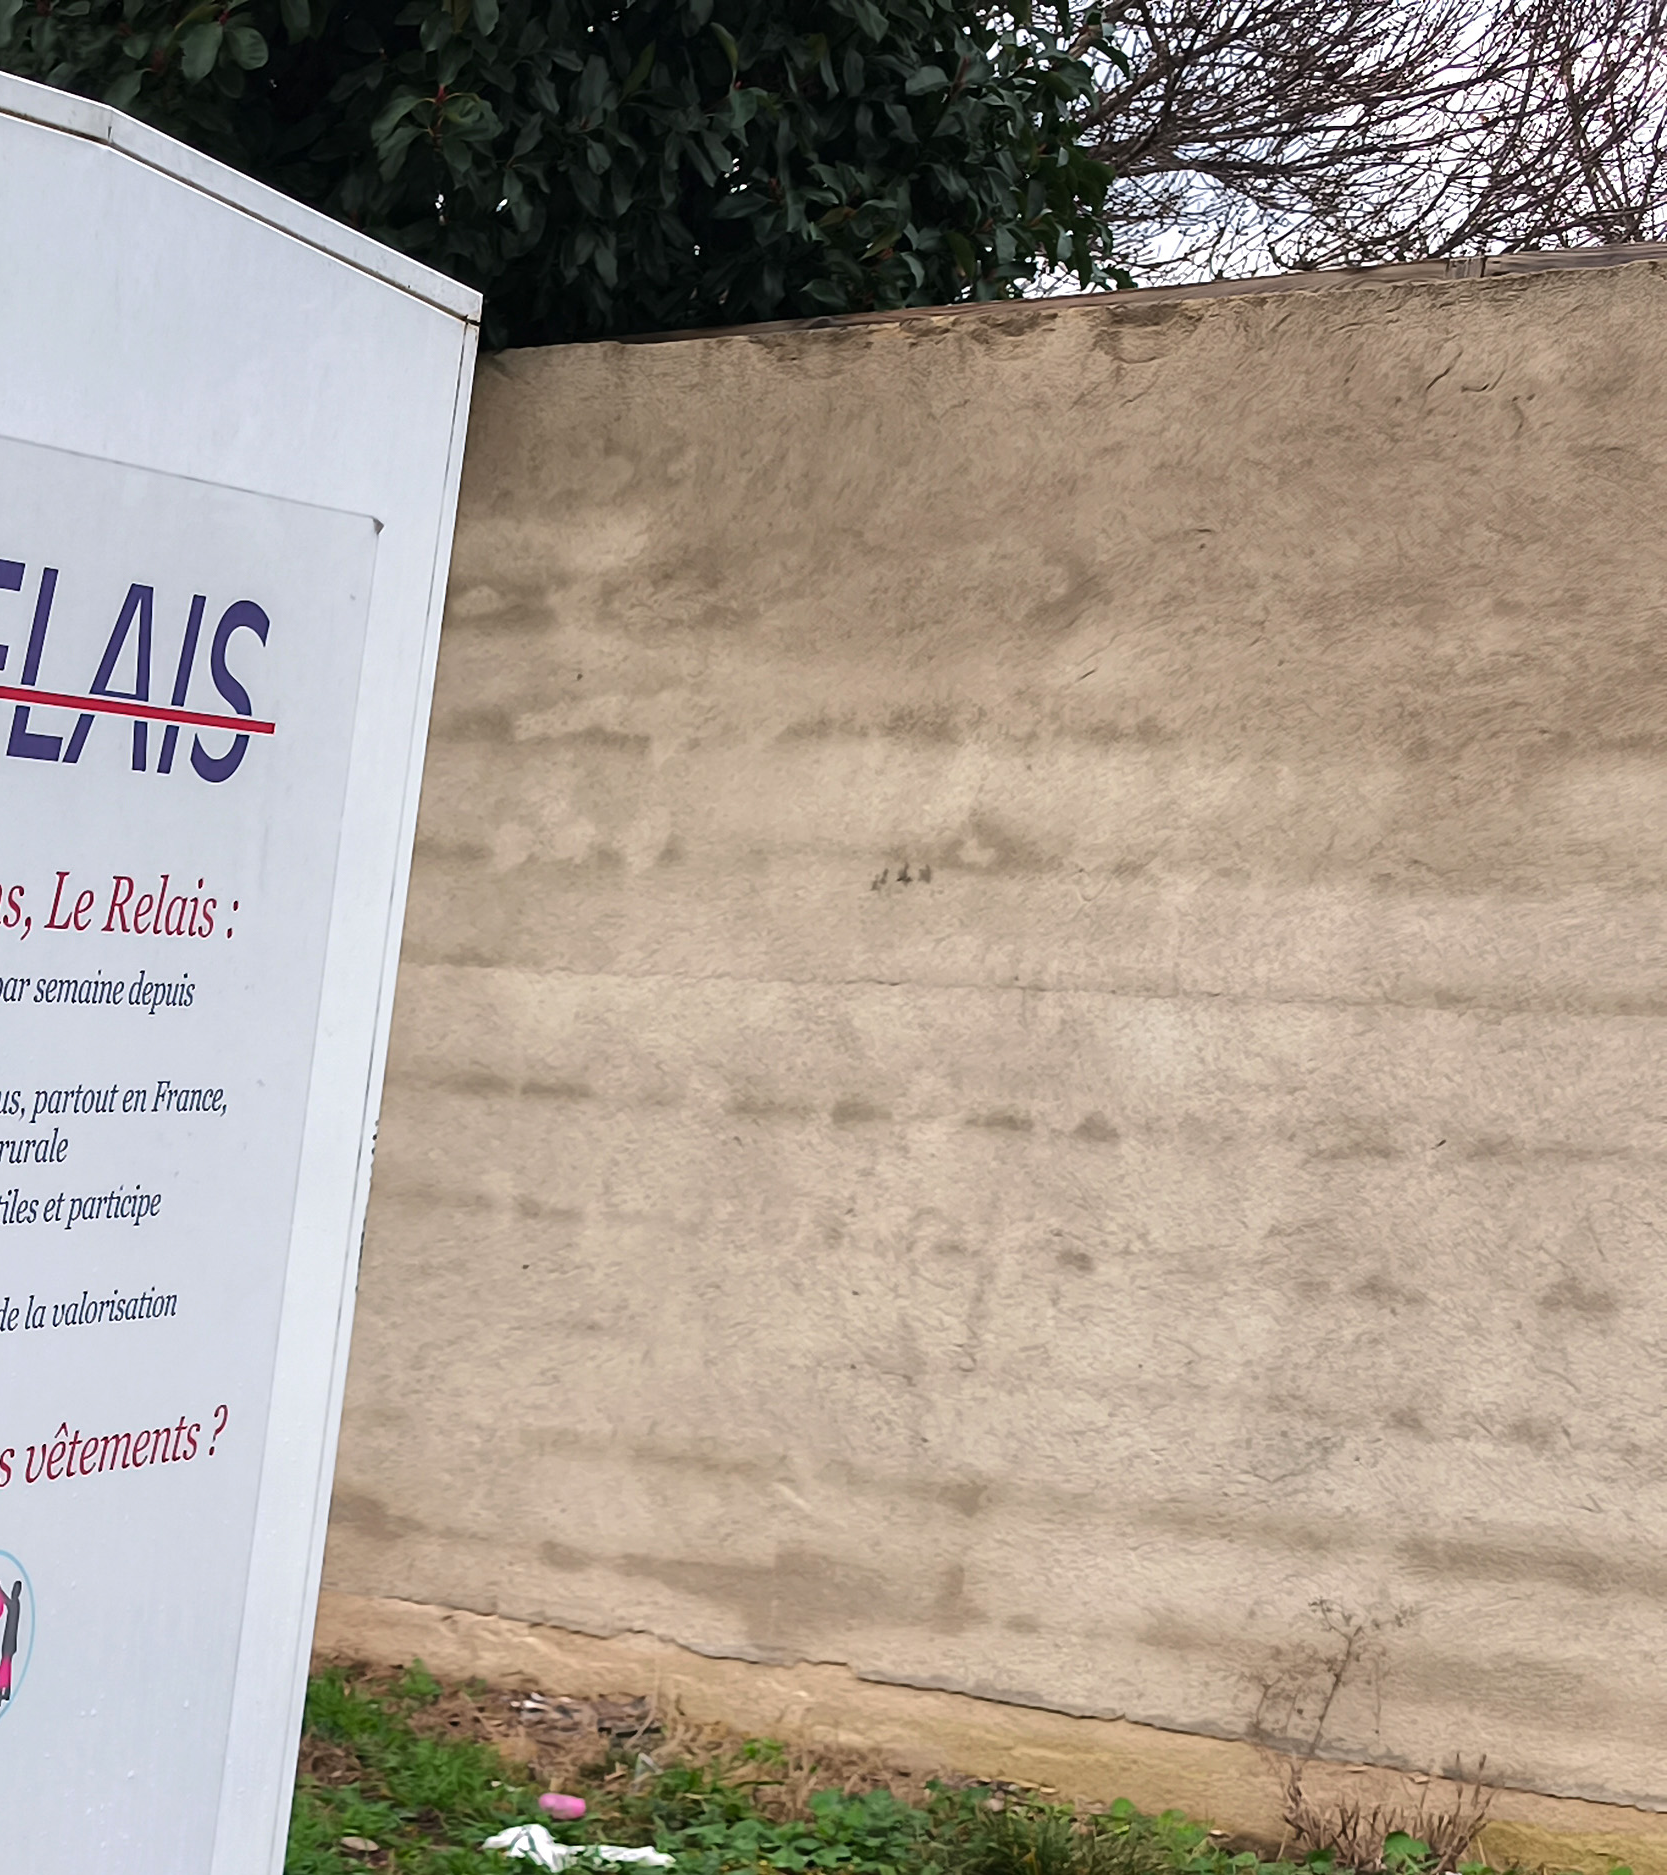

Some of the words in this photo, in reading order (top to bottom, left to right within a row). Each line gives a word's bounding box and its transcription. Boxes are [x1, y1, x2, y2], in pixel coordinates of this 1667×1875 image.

[44, 871, 94, 931] Le
[102, 874, 217, 938] Relais
[33, 970, 124, 1006] semaine
[127, 970, 195, 1014] depuis
[29, 1083, 117, 1124] partout
[121, 1089, 147, 1113] en
[150, 1080, 228, 1117] France,
[43, 1189, 65, 1222] et
[65, 1184, 162, 1230] participe
[24, 1295, 45, 1330] la
[51, 1285, 177, 1328] valorisation
[25, 1410, 201, 1484] vêtements
